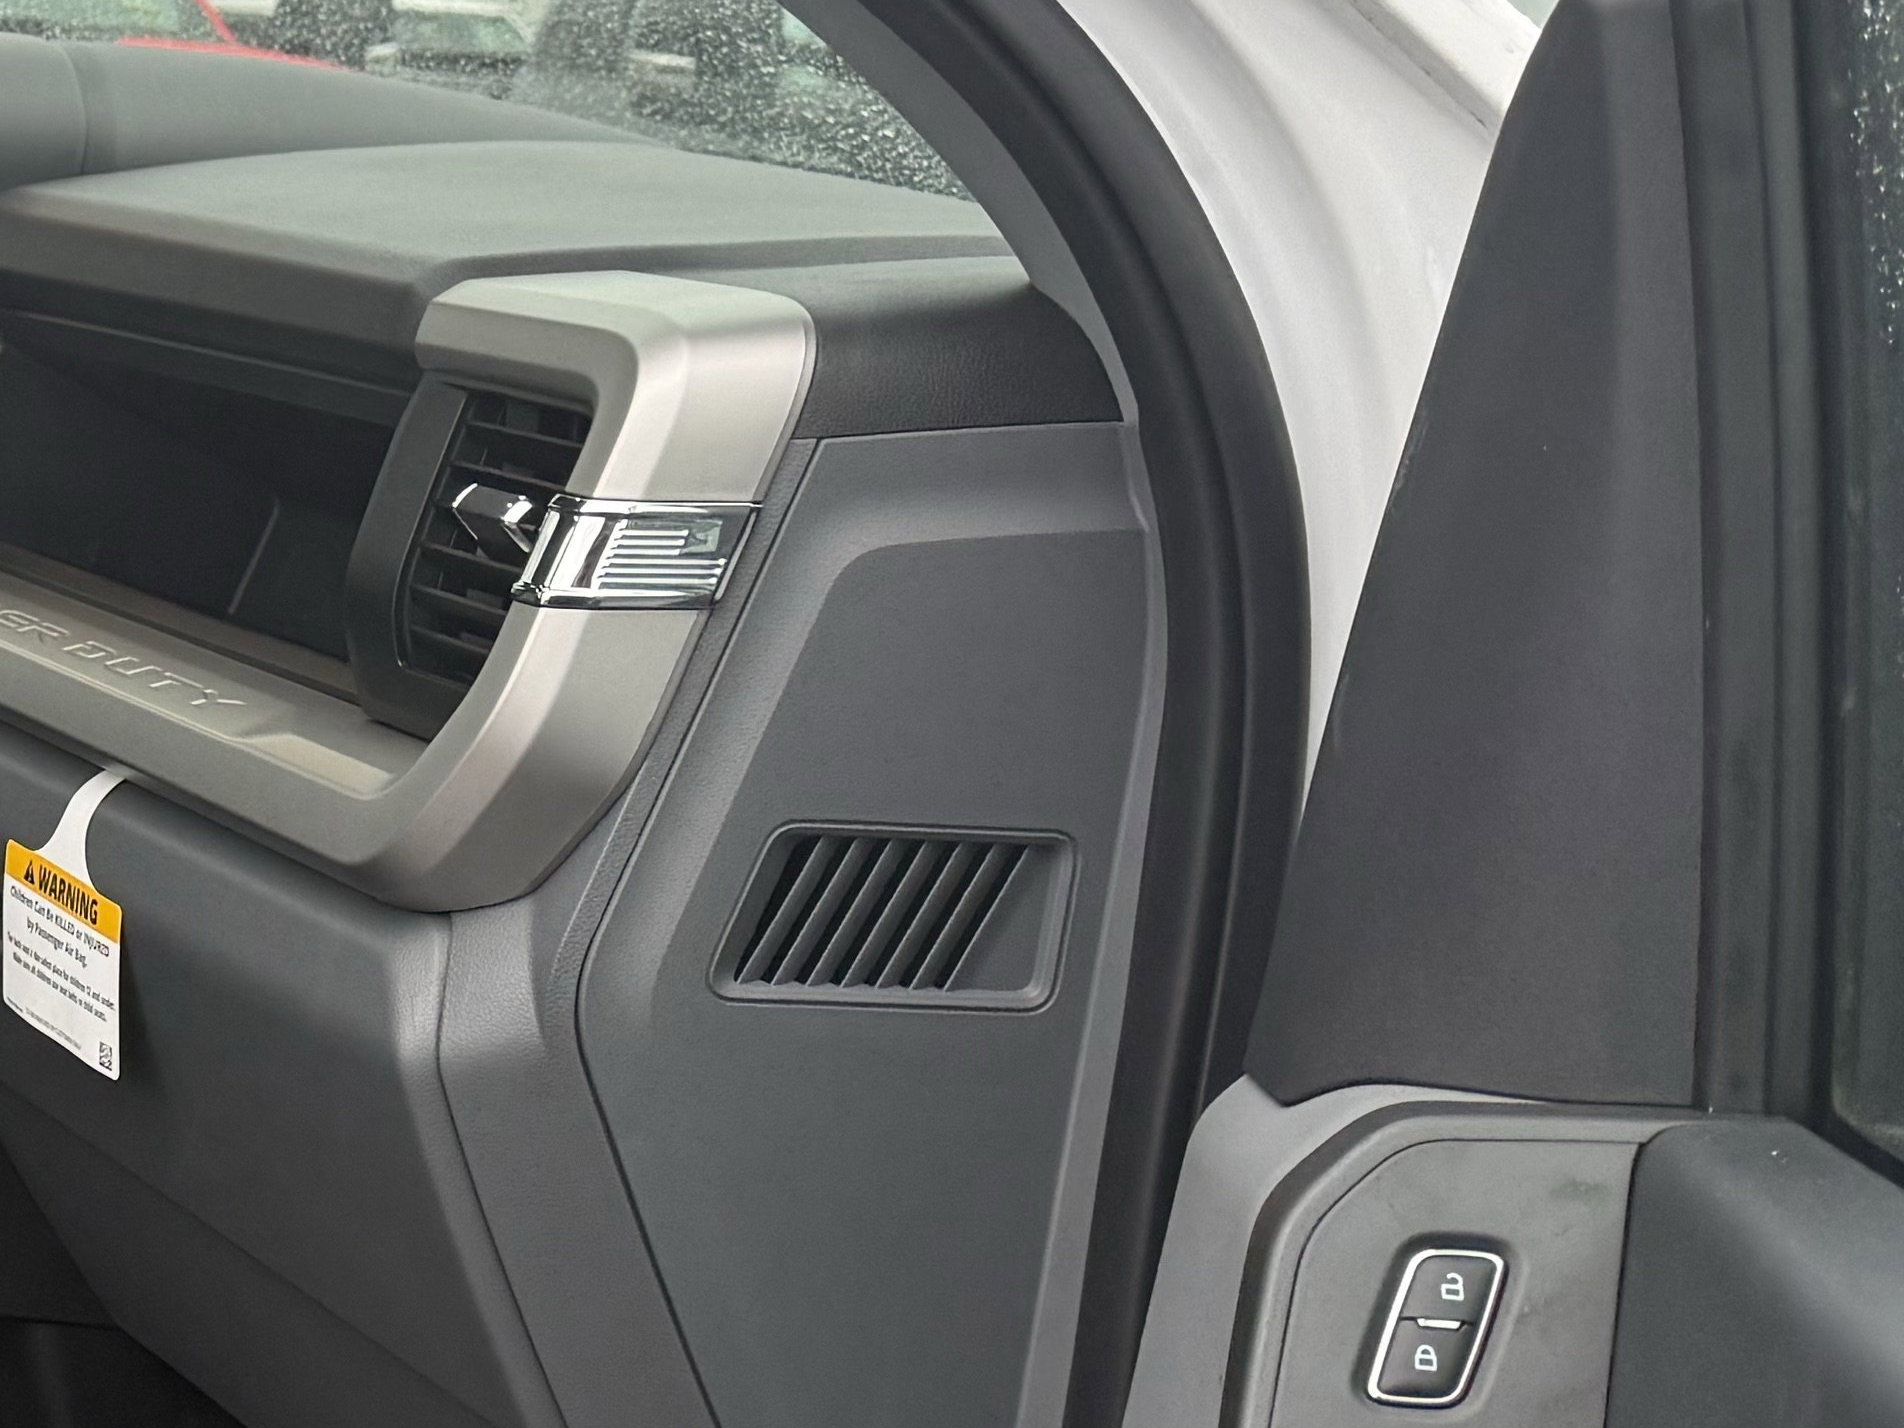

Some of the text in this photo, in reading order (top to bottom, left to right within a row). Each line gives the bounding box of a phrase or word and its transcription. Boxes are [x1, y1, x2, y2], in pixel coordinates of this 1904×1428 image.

[62, 639, 247, 707] DUTY
[11, 885, 34, 909] Children
[55, 914, 75, 935] KILLED
[39, 865, 98, 925] WARNING
